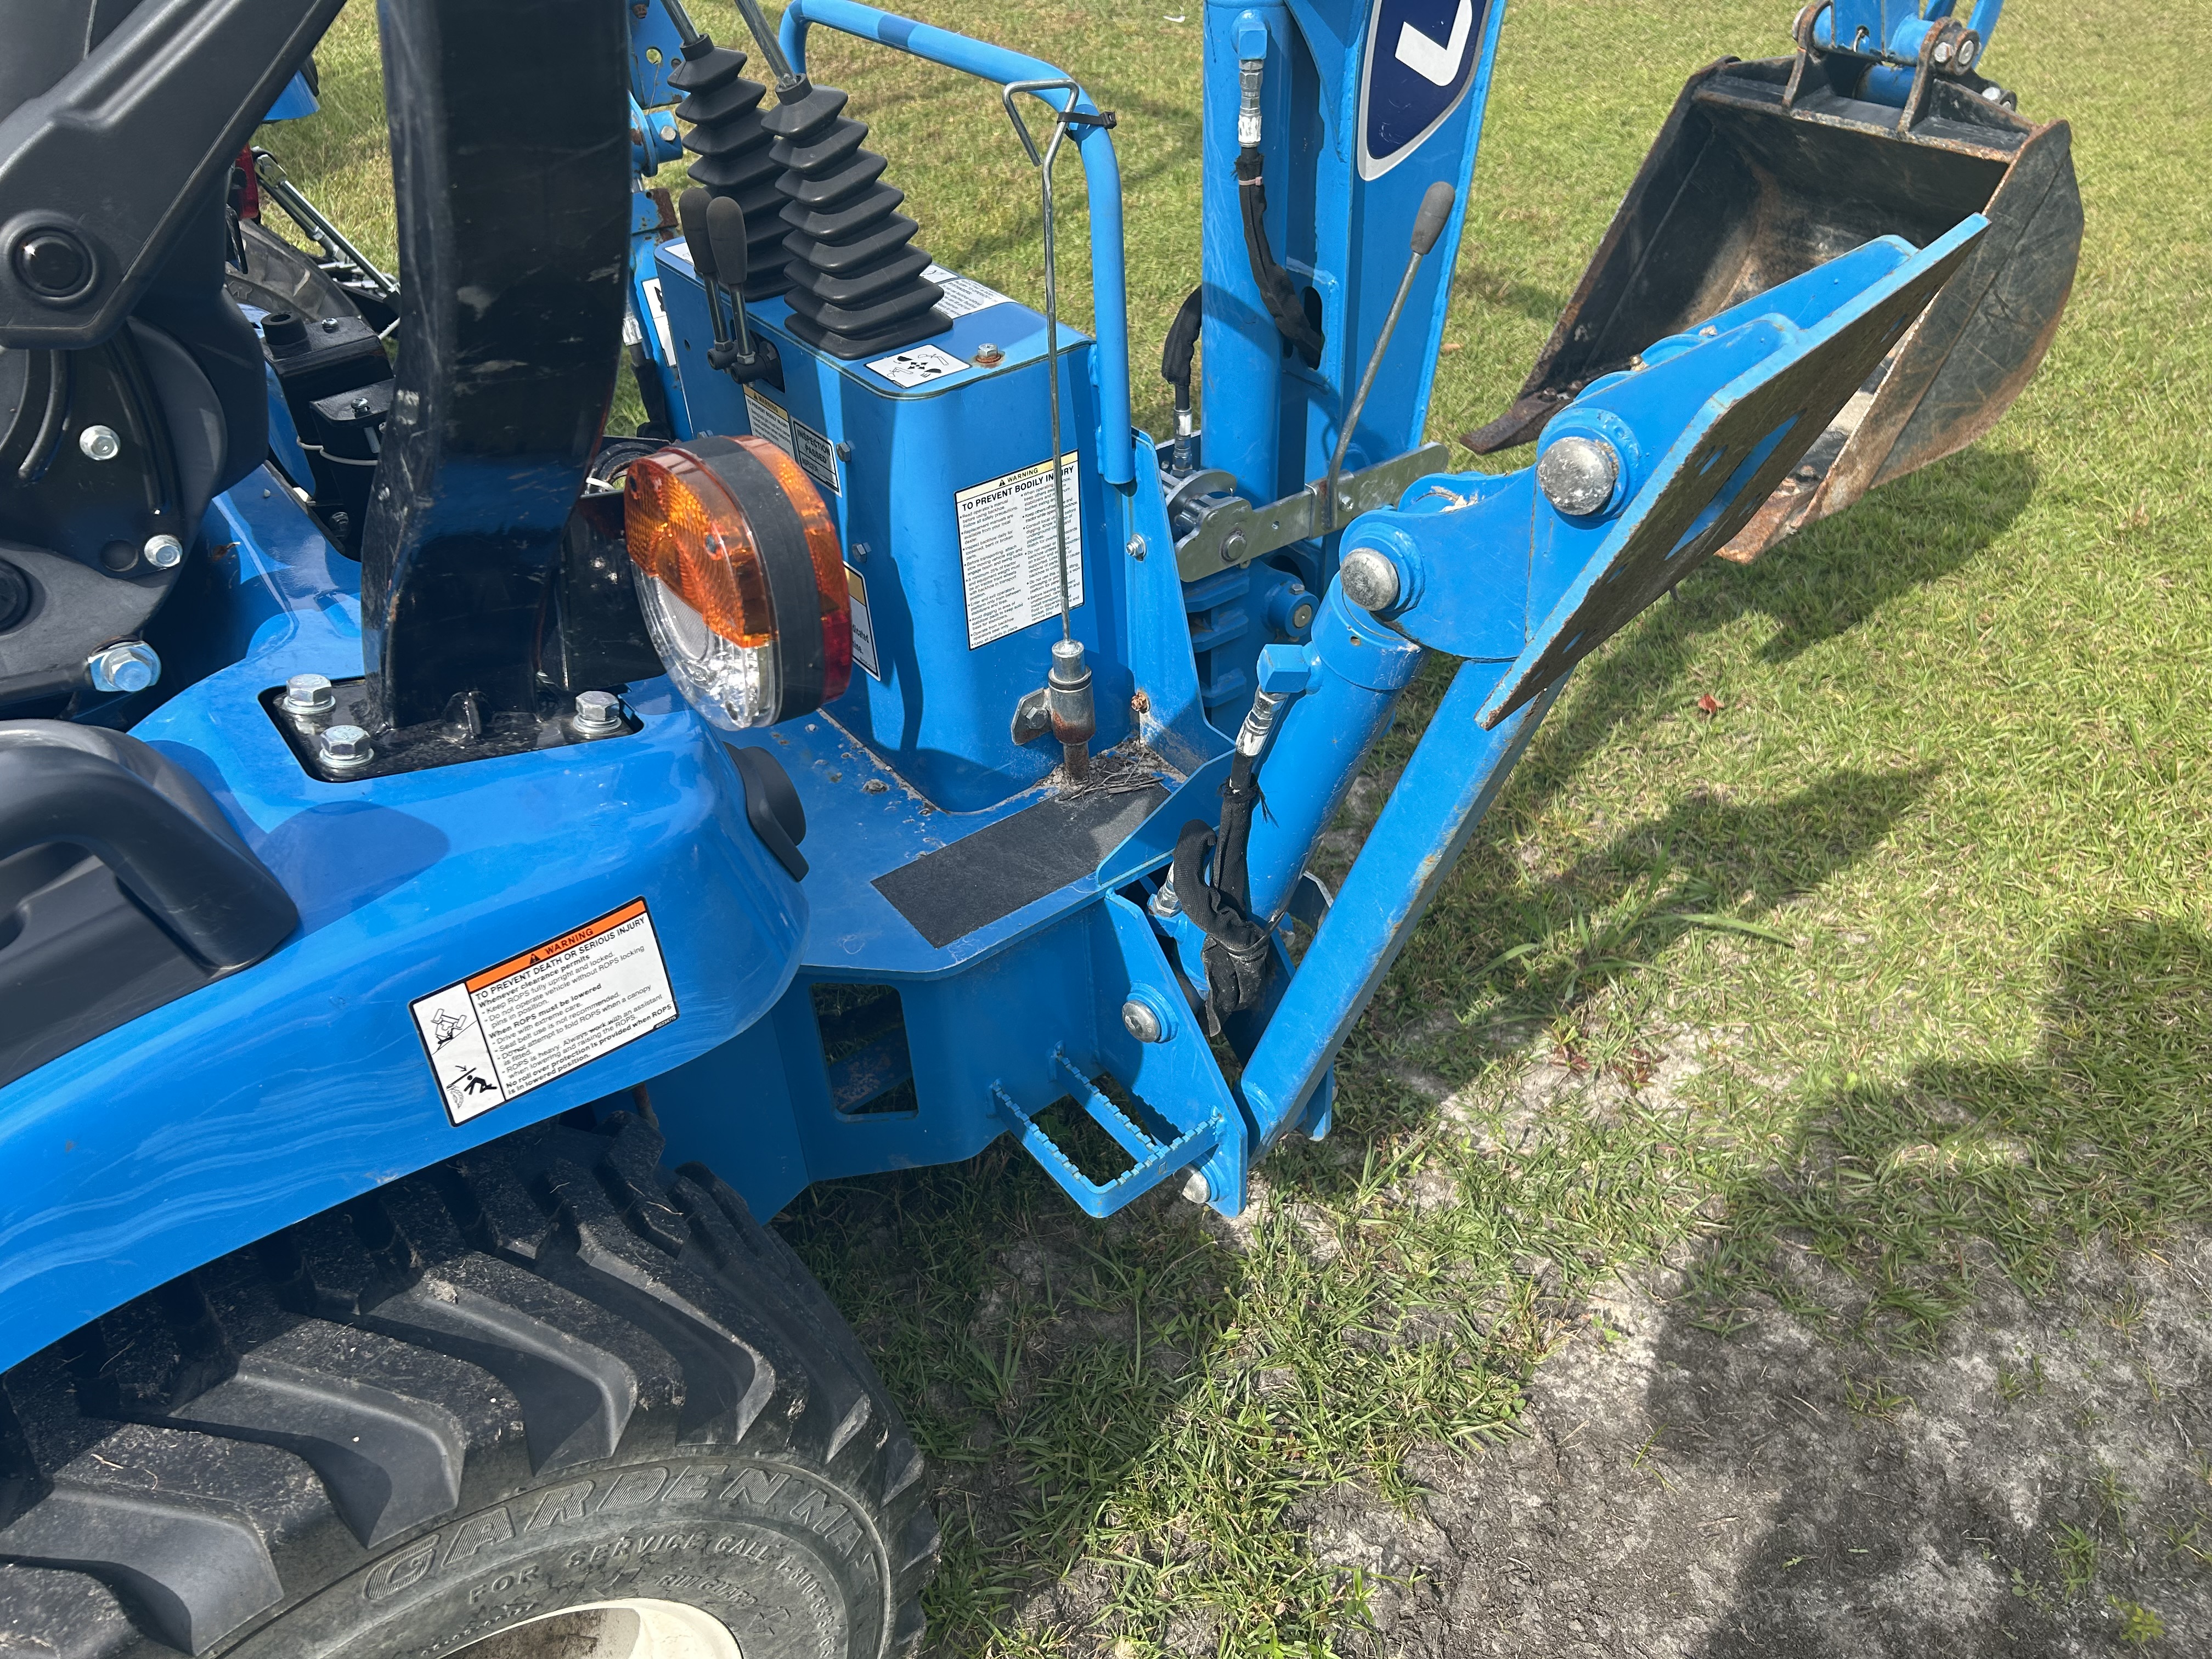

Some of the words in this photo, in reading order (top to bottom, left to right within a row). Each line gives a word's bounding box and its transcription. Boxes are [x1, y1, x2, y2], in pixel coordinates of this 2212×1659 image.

[797, 428, 831, 456] INSPECTION
[805, 444, 827, 464] PASSED
[962, 501, 973, 511] TO
[975, 487, 1013, 507] PREVENT
[1015, 476, 1043, 493] BODILY
[1046, 465, 1074, 482] INRY
[1007, 467, 1038, 483] WARNING
[475, 990, 488, 1000] TO
[490, 970, 531, 995] PREVENT
[533, 956, 563, 975] DEATH
[564, 950, 577, 961] OR
[578, 932, 616, 954] SERIOUS
[616, 916, 644, 936] INJURY
[544, 928, 594, 955] WARNING
[477, 987, 519, 1008] Whenever
[521, 969, 559, 990] clearance
[560, 955, 590, 973] permits
[486, 1002, 506, 1014] Keep
[507, 990, 530, 1005] ROPS
[531, 983, 546, 994] fully
[548, 970, 574, 986] upright
[575, 962, 589, 974] and
[590, 951, 614, 967] locked.
[488, 1013, 501, 1022] Do
[501, 1006, 515, 1016] not
[515, 994, 544, 1009] operate
[544, 981, 571, 996] vehicle
[571, 968, 598, 984] without
[598, 957, 619, 971] ROPS
[620, 946, 645, 961] locking
[488, 1026, 512, 1039] When
[513, 1013, 537, 1028] ROPS
[538, 1003, 558, 1017] must
[571, 983, 602, 1002] lowered
[490, 1018, 508, 1030] pins
[517, 1000, 549, 1018] position.
[496, 1032, 517, 1045] Drive
[517, 1024, 534, 1034] with
[534, 1011, 564, 1027] extreme
[565, 1002, 583, 1013] care.
[499, 1040, 517, 1052] Seat
[517, 1032, 532, 1043] belt
[533, 1027, 547, 1036] use
[555, 1016, 568, 1025] not
[568, 991, 620, 1019] recommended.
[501, 1050, 514, 1059] Do
[513, 1044, 527, 1053] not
[527, 1030, 556, 1047] attempt
[564, 1019, 579, 1030] fold
[579, 1009, 601, 1023] ROPS
[602, 1000, 621, 1012] when
[627, 985, 651, 1000] canopy
[506, 1058, 529, 1073] ROPS
[538, 1044, 561, 1058] heavy.
[563, 1031, 589, 1047] Always
[589, 1022, 607, 1033] work
[608, 1015, 623, 1025] with
[633, 994, 663, 1012] assistant
[508, 1066, 529, 1079] when
[529, 1050, 562, 1069] lowering
[563, 1043, 577, 1054] and
[577, 1031, 602, 1047] raising
[602, 1026, 614, 1034] the
[614, 1014, 637, 1028] ROPS.
[511, 1049, 533, 1062] fitted.
[518, 1072, 532, 1083] roll
[533, 1064, 550, 1076] over
[551, 1046, 590, 1069] protection
[599, 1024, 631, 1046] provided
[632, 1015, 651, 1028] when
[651, 1004, 672, 1018] ROPS
[524, 1067, 557, 1087] lowered
[557, 1054, 590, 1073] position.
[469, 1565, 539, 1605] FOR
[567, 1532, 706, 1569] SERVICE
[715, 1536, 770, 1562] CALL
